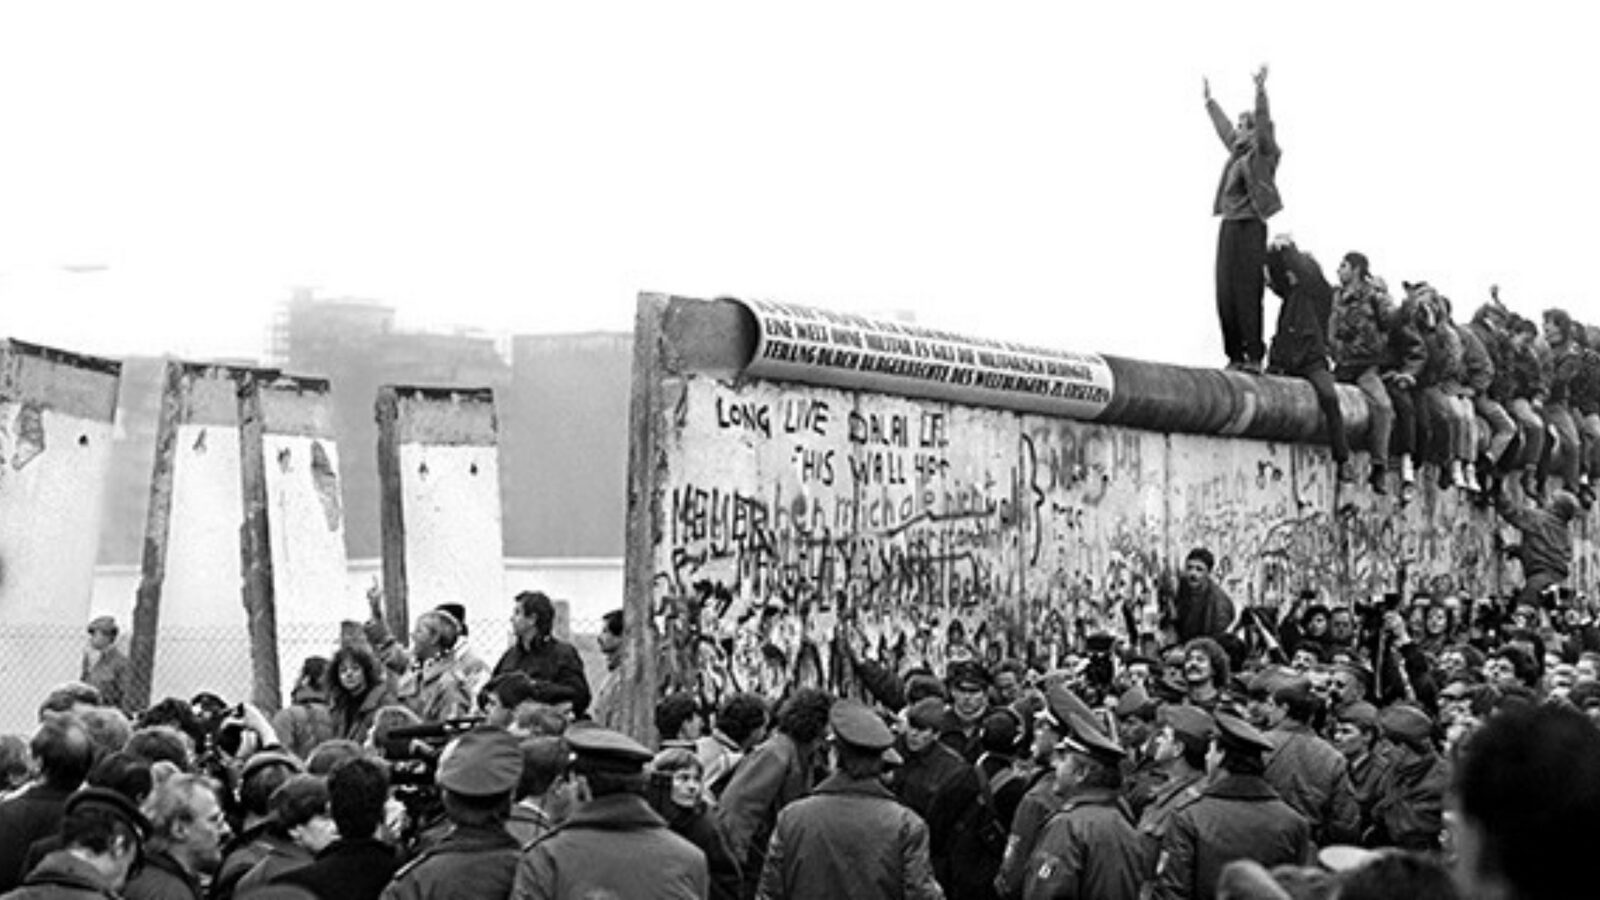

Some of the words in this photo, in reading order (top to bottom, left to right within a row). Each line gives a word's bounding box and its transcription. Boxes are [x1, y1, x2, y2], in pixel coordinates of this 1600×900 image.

[716, 396, 772, 439] LONG
[784, 398, 829, 436] LIVE
[847, 410, 907, 448] DALAI
[847, 451, 906, 485] WALL
